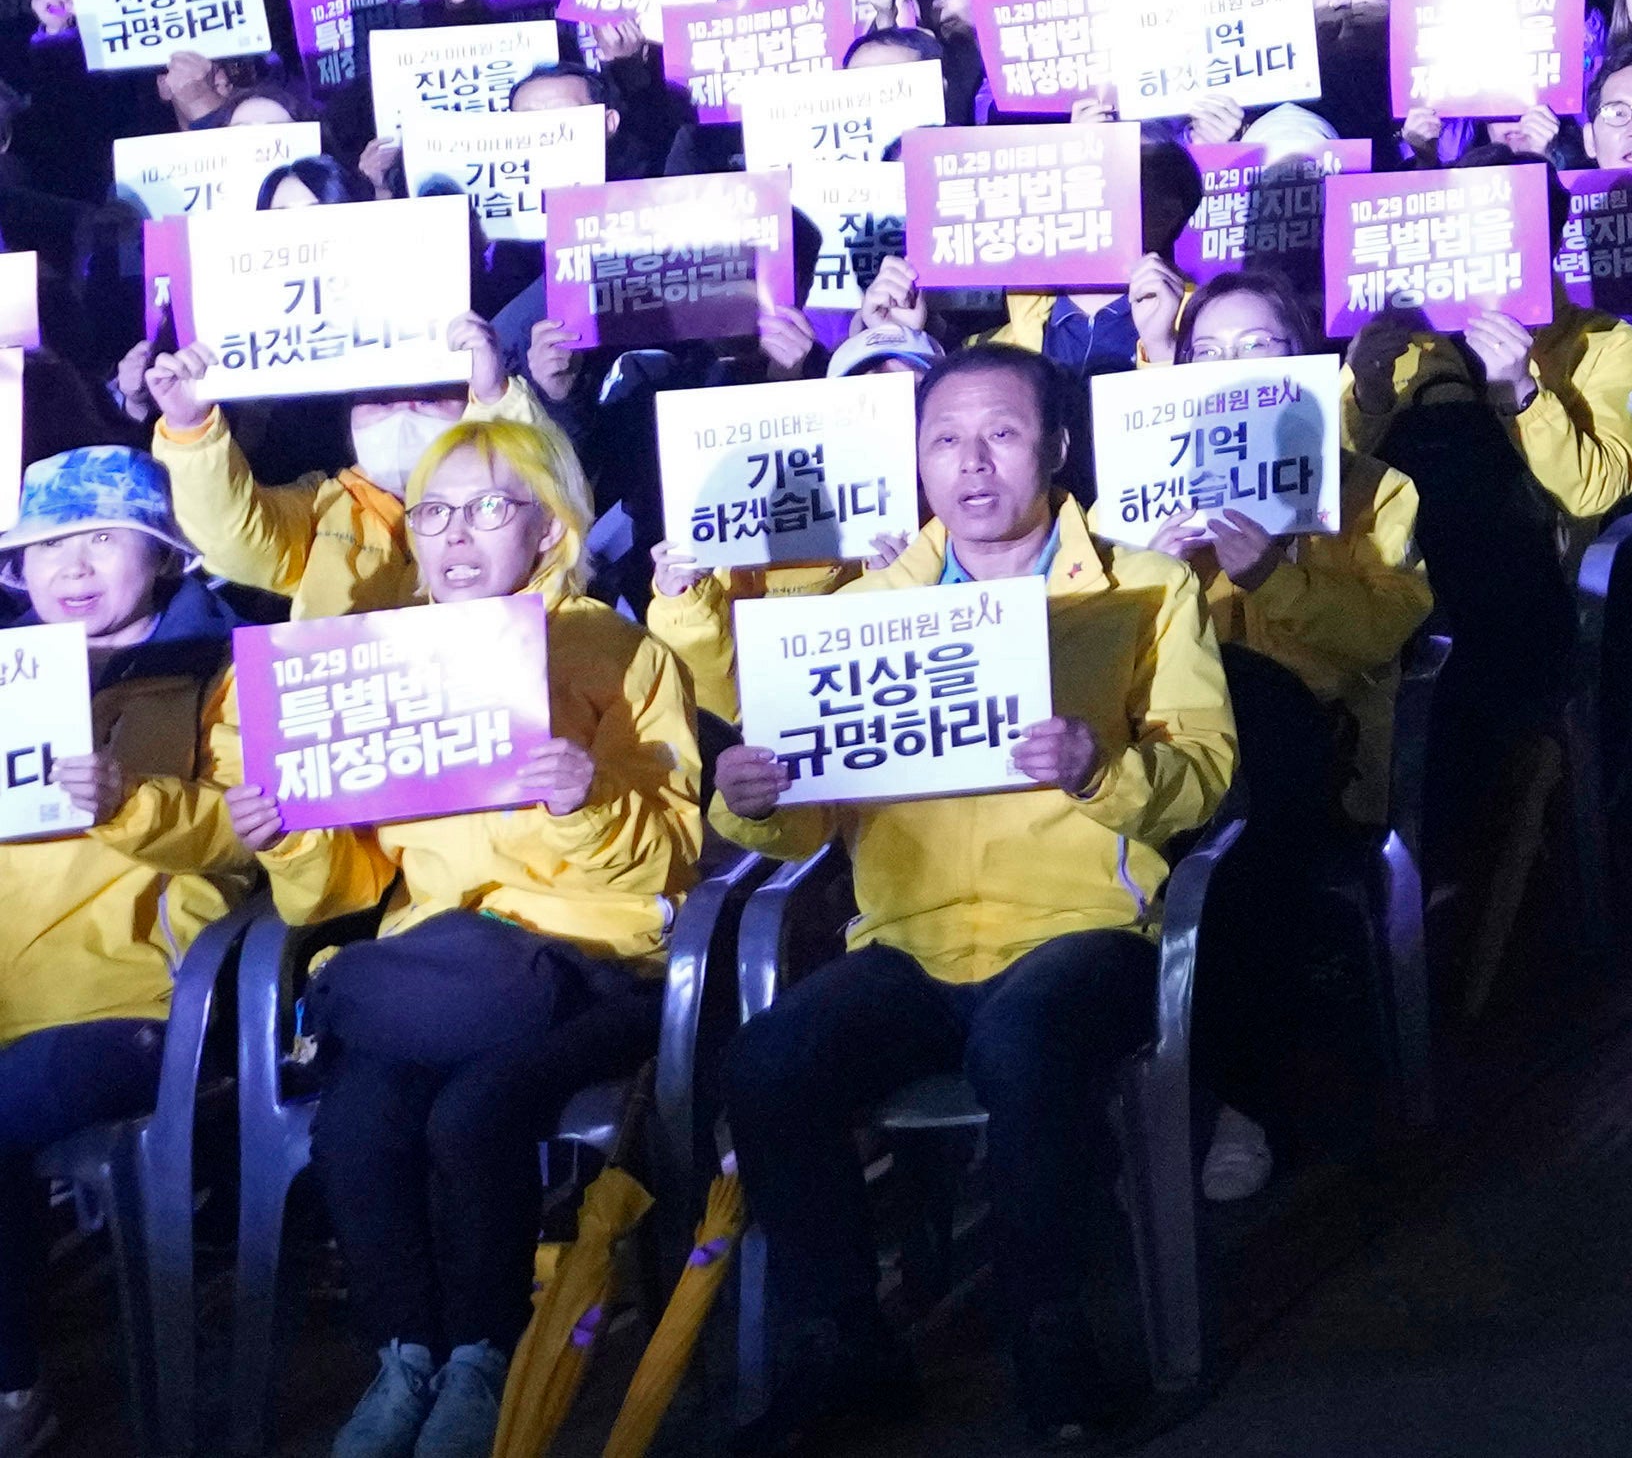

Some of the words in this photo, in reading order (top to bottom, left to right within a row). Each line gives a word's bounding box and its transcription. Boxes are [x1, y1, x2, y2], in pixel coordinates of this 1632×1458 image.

[102, 1, 245, 53] 규명하라!
[466, 160, 531, 188] 기억
[934, 151, 986, 175] 10.29
[1351, 200, 1401, 225] 10.29
[931, 218, 1111, 265] 제정하라!
[1123, 404, 1175, 432] 10.29
[1180, 386, 1250, 418] 이태원
[693, 425, 752, 451] 10.29
[1168, 422, 1249, 464] 기억
[747, 450, 826, 485] 기억
[690, 478, 889, 545] 하겠습니다
[779, 625, 852, 660] 10.29
[861, 615, 941, 650] 이태원
[273, 647, 346, 683] 10.29
[808, 639, 977, 714] 진상을
